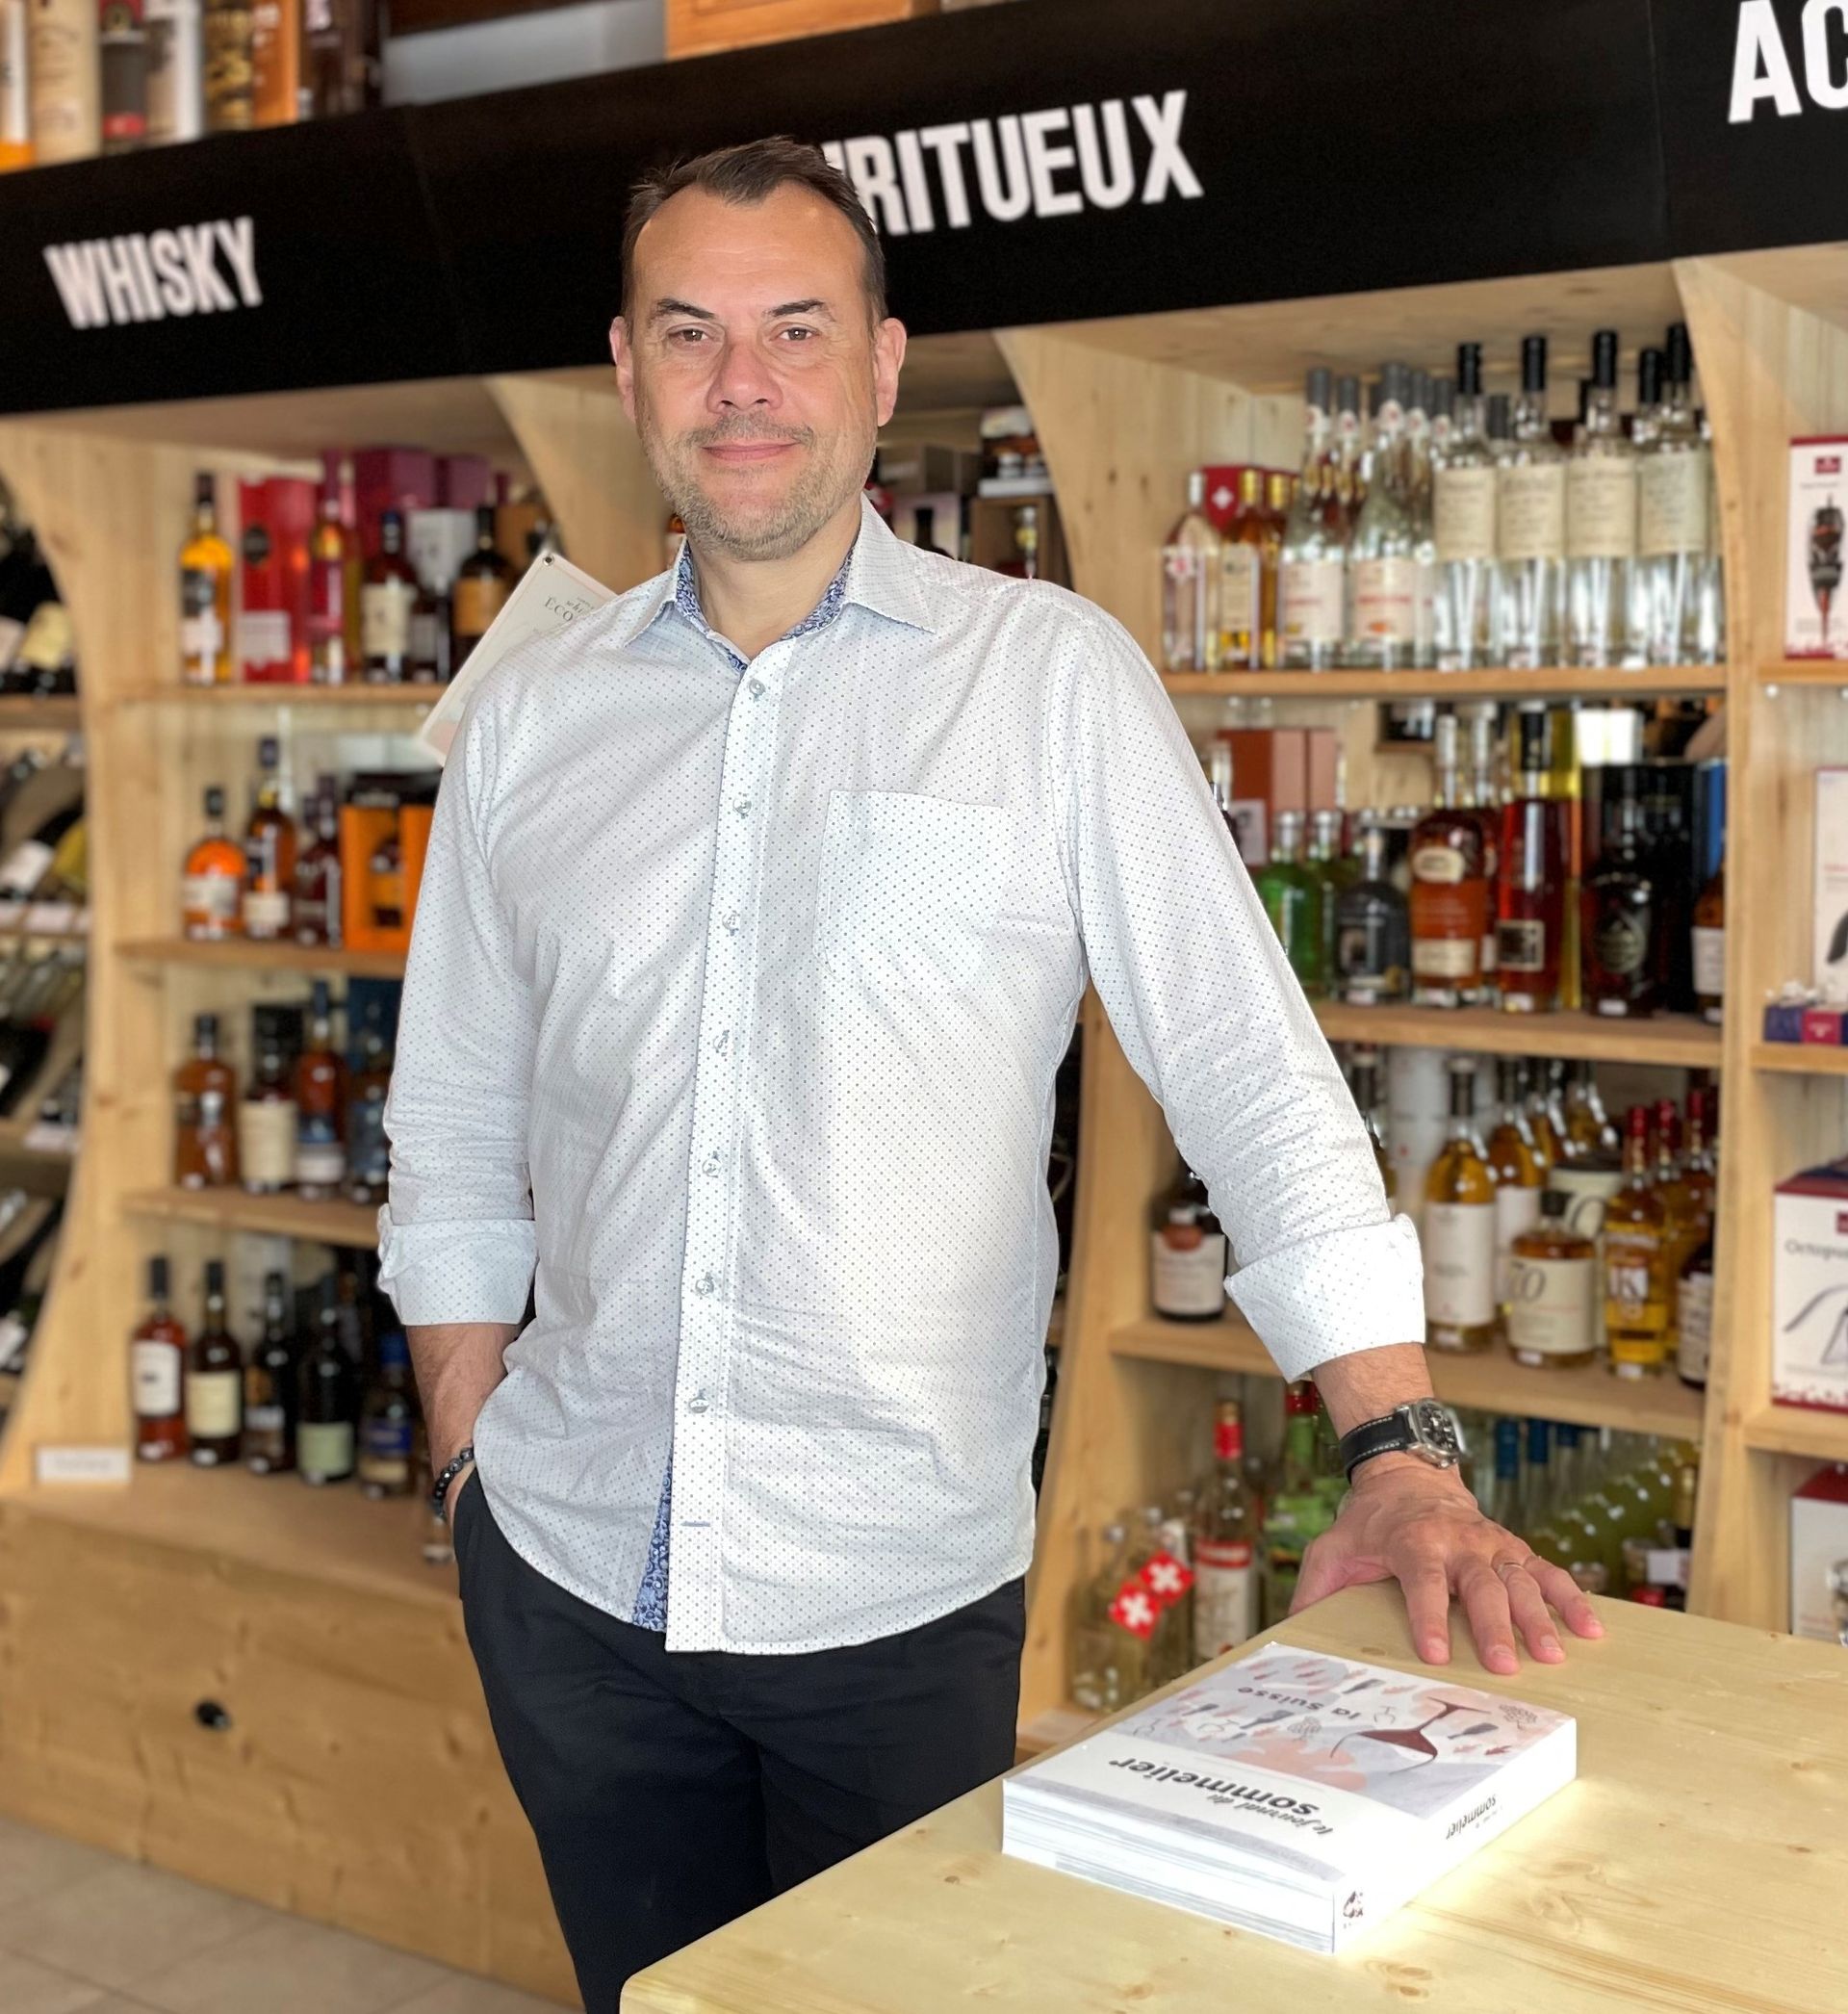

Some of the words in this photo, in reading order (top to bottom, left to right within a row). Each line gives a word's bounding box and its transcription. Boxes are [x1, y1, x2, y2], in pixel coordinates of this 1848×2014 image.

[1729, 0, 1848, 123] AC
[821, 90, 1203, 236] RITUEUX
[43, 217, 262, 329] WHISKY
[1331, 1707, 1361, 1719] la
[1108, 1757, 1320, 1816] sommelier
[1233, 1799, 1322, 1828] journal
[1446, 1794, 1497, 1840] sommelier
